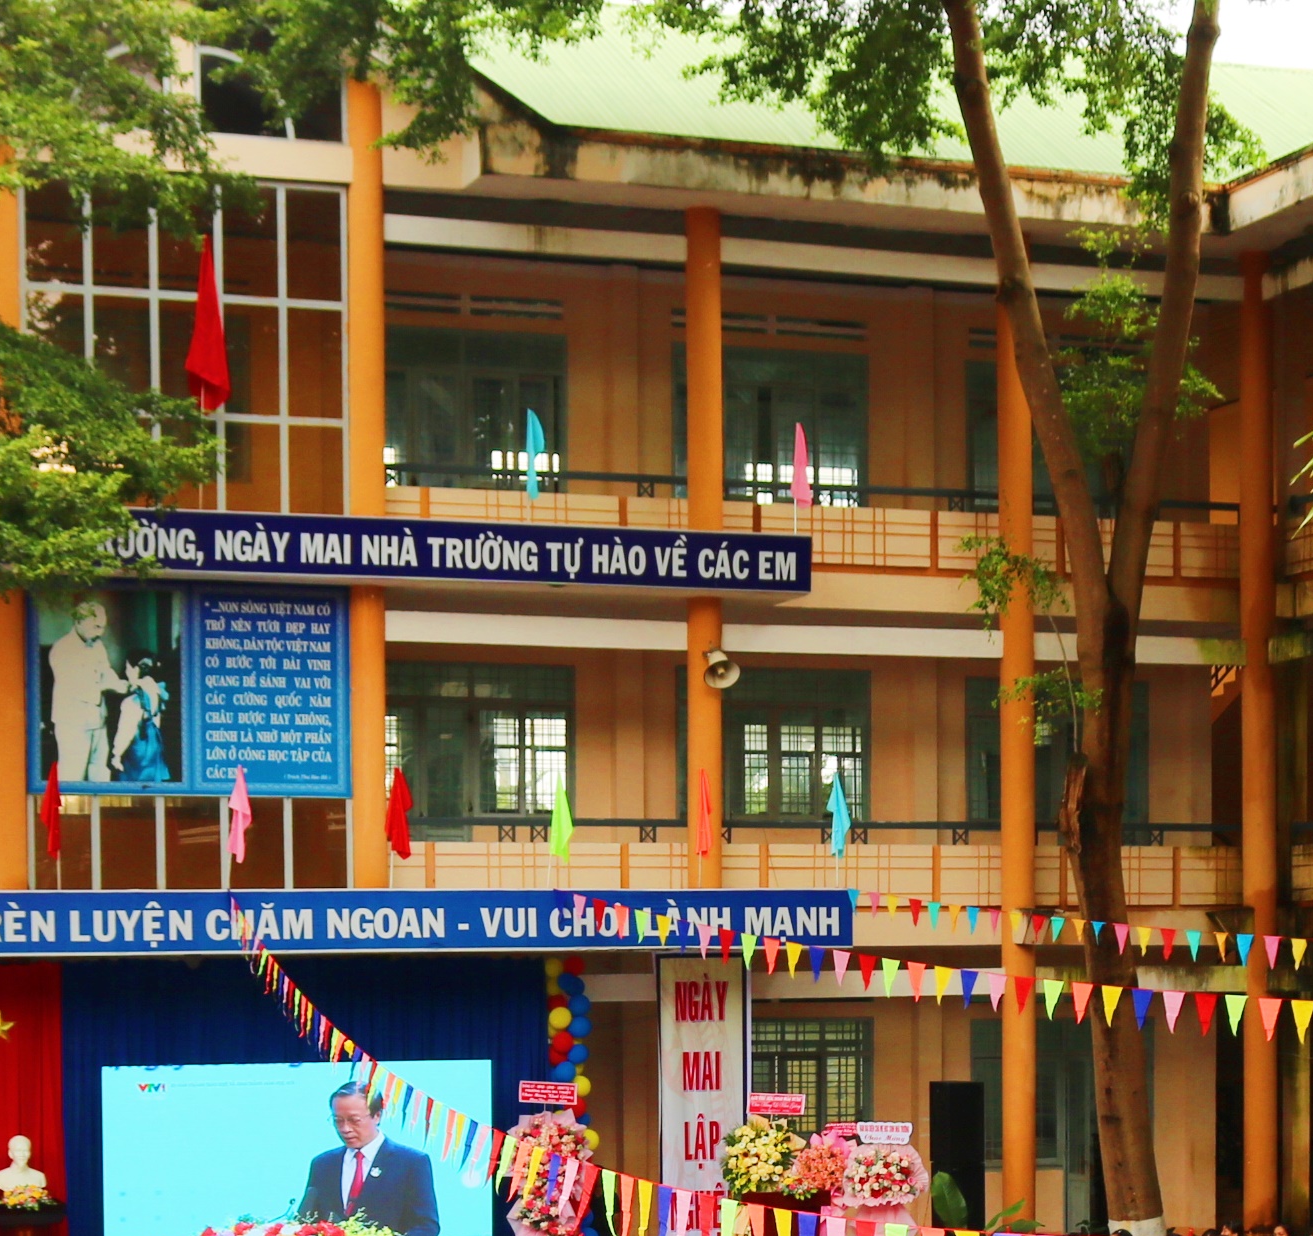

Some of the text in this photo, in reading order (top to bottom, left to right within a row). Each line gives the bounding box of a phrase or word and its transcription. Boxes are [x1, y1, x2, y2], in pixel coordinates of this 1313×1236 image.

[213, 523, 289, 562] NGÀY
[300, 533, 351, 565] MAI
[361, 526, 417, 568] NHÀ
[428, 533, 537, 572] TRƯỜNG
[546, 539, 583, 579] TỰ
[592, 535, 644, 576] HÀO
[656, 534, 687, 577] VỀ
[697, 537, 748, 580] CÁC
[759, 552, 796, 581] EM
[241, 599, 266, 614] SÔNG
[269, 601, 292, 617] VIỆT
[294, 604, 314, 615] NAM
[317, 602, 330, 615] CÓ
[206, 616, 226, 631] TRỞ
[311, 623, 330, 634] HAY
[309, 641, 330, 652] NAM
[205, 654, 219, 667] CÓ
[308, 659, 331, 670] VINH
[206, 675, 239, 688] QUANG
[294, 677, 311, 688] VAI
[206, 690, 226, 704] CÁC
[270, 713, 290, 725] HAY
[240, 728, 254, 742] LÀ
[206, 764, 226, 778] CÁC
[69, 902, 193, 949] LUYỆN
[205, 902, 313, 940] CHĂM
[327, 907, 445, 939] NGOAN
[482, 908, 538, 938] VUI
[643, 898, 731, 937] LÀNH
[745, 906, 840, 944] MẠNH
[674, 972, 729, 1023] NGÀY
[683, 1051, 721, 1091] MAI
[684, 1112, 719, 1170] LẬP
